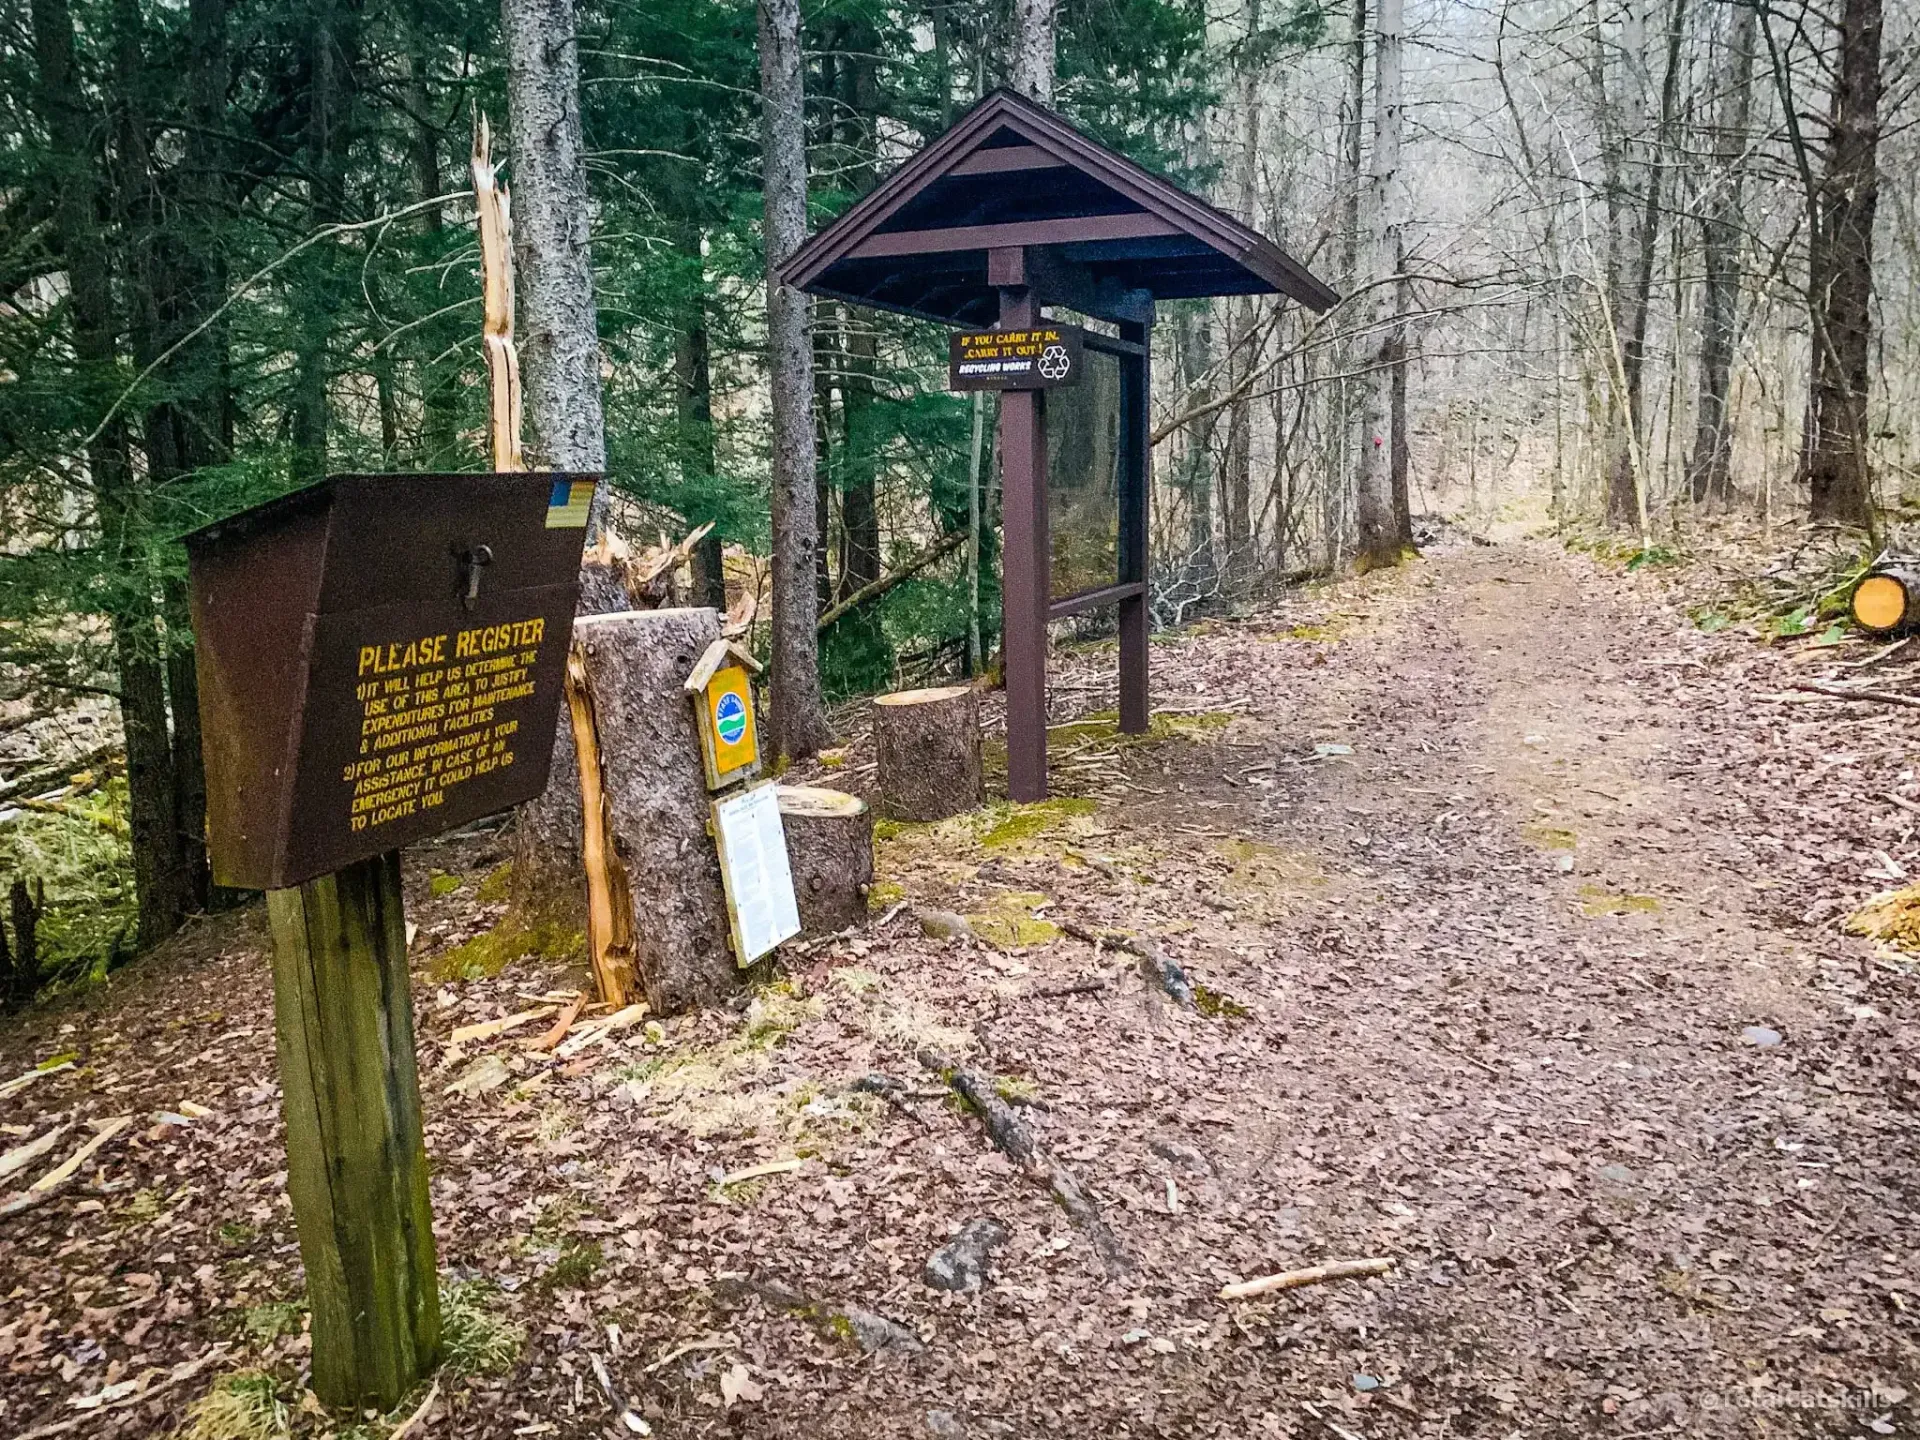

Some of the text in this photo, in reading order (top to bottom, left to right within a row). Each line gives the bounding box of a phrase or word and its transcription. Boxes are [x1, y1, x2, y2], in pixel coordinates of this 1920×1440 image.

[961, 336, 971, 347] IF
[975, 335, 993, 345] YOU
[996, 333, 1027, 344] CARRY
[1031, 332, 1042, 342] IT
[1002, 346, 1012, 357] IT
[959, 361, 1032, 374] RECYCLING WORKS
[358, 617, 545, 677] PLEASE REGISTER
[364, 667, 528, 717] USE OF THIS AREA TO JUSTIFY
[384, 676, 410, 694] WILL
[415, 670, 444, 688] HELP
[447, 666, 462, 682] US
[465, 654, 518, 677] DETERMINE
[520, 649, 538, 665] THE
[359, 707, 495, 754] & ADDITIONAL FACILITIES
[362, 680, 536, 736] EXPENDITURES FOR MAINTENANCE
[355, 739, 506, 796] ASSISTANCE IN CASE OF AN
[385, 750, 410, 769] OUR
[413, 731, 481, 762] INFORMATION
[483, 728, 491, 743] &
[494, 720, 519, 739] YOUR
[351, 751, 515, 814] EMERGENCY IT COULD HELP US
[350, 814, 368, 833] TO
[371, 798, 417, 827] LOCATE
